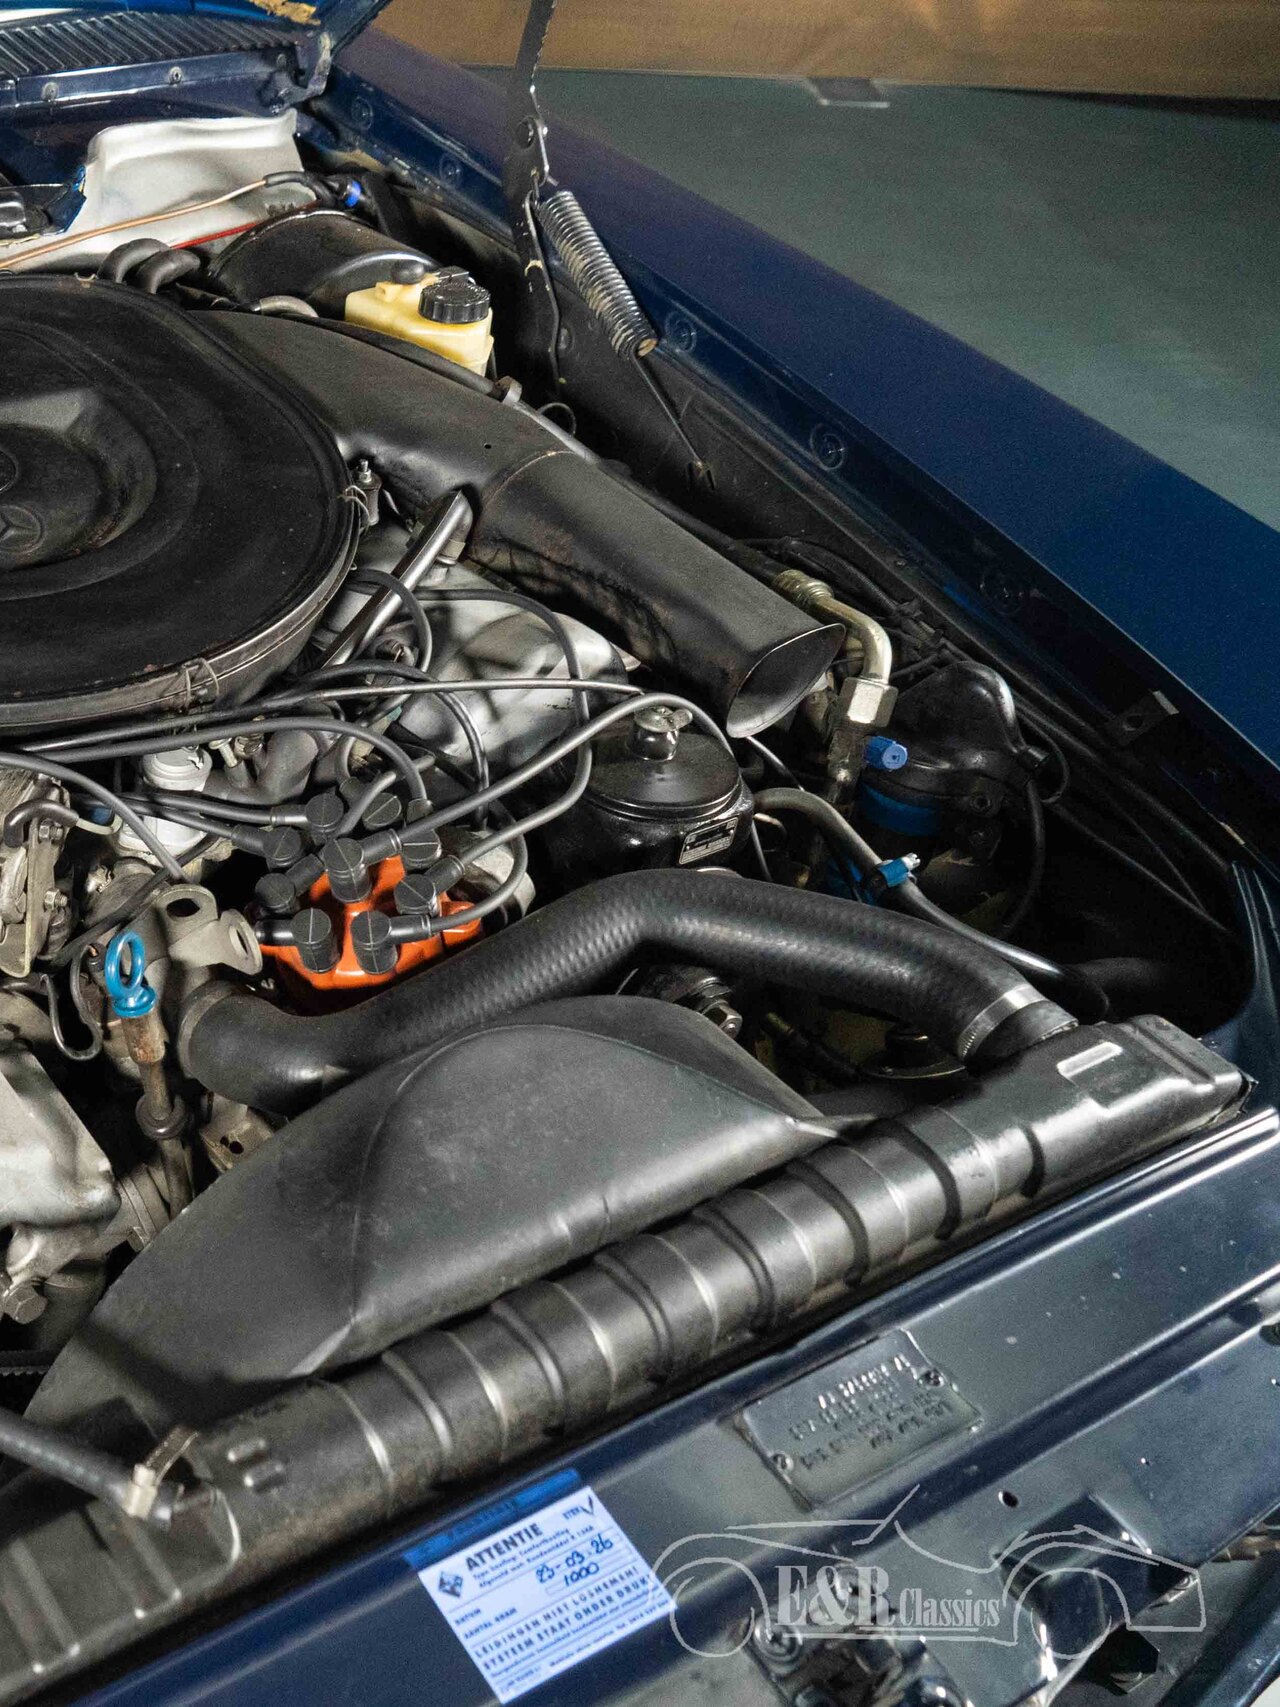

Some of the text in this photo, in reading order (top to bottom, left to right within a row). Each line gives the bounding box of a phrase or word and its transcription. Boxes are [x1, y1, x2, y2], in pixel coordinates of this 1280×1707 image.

[464, 1522, 544, 1571] ATTENTIE
[563, 1562, 600, 1586] 1000
[473, 1617, 541, 1659] LEIDINGEN
[541, 1601, 571, 1622] NIET
[482, 1637, 535, 1671] SYSTEEM
[535, 1616, 572, 1641] STAAT
[572, 1593, 615, 1621] ONDER
